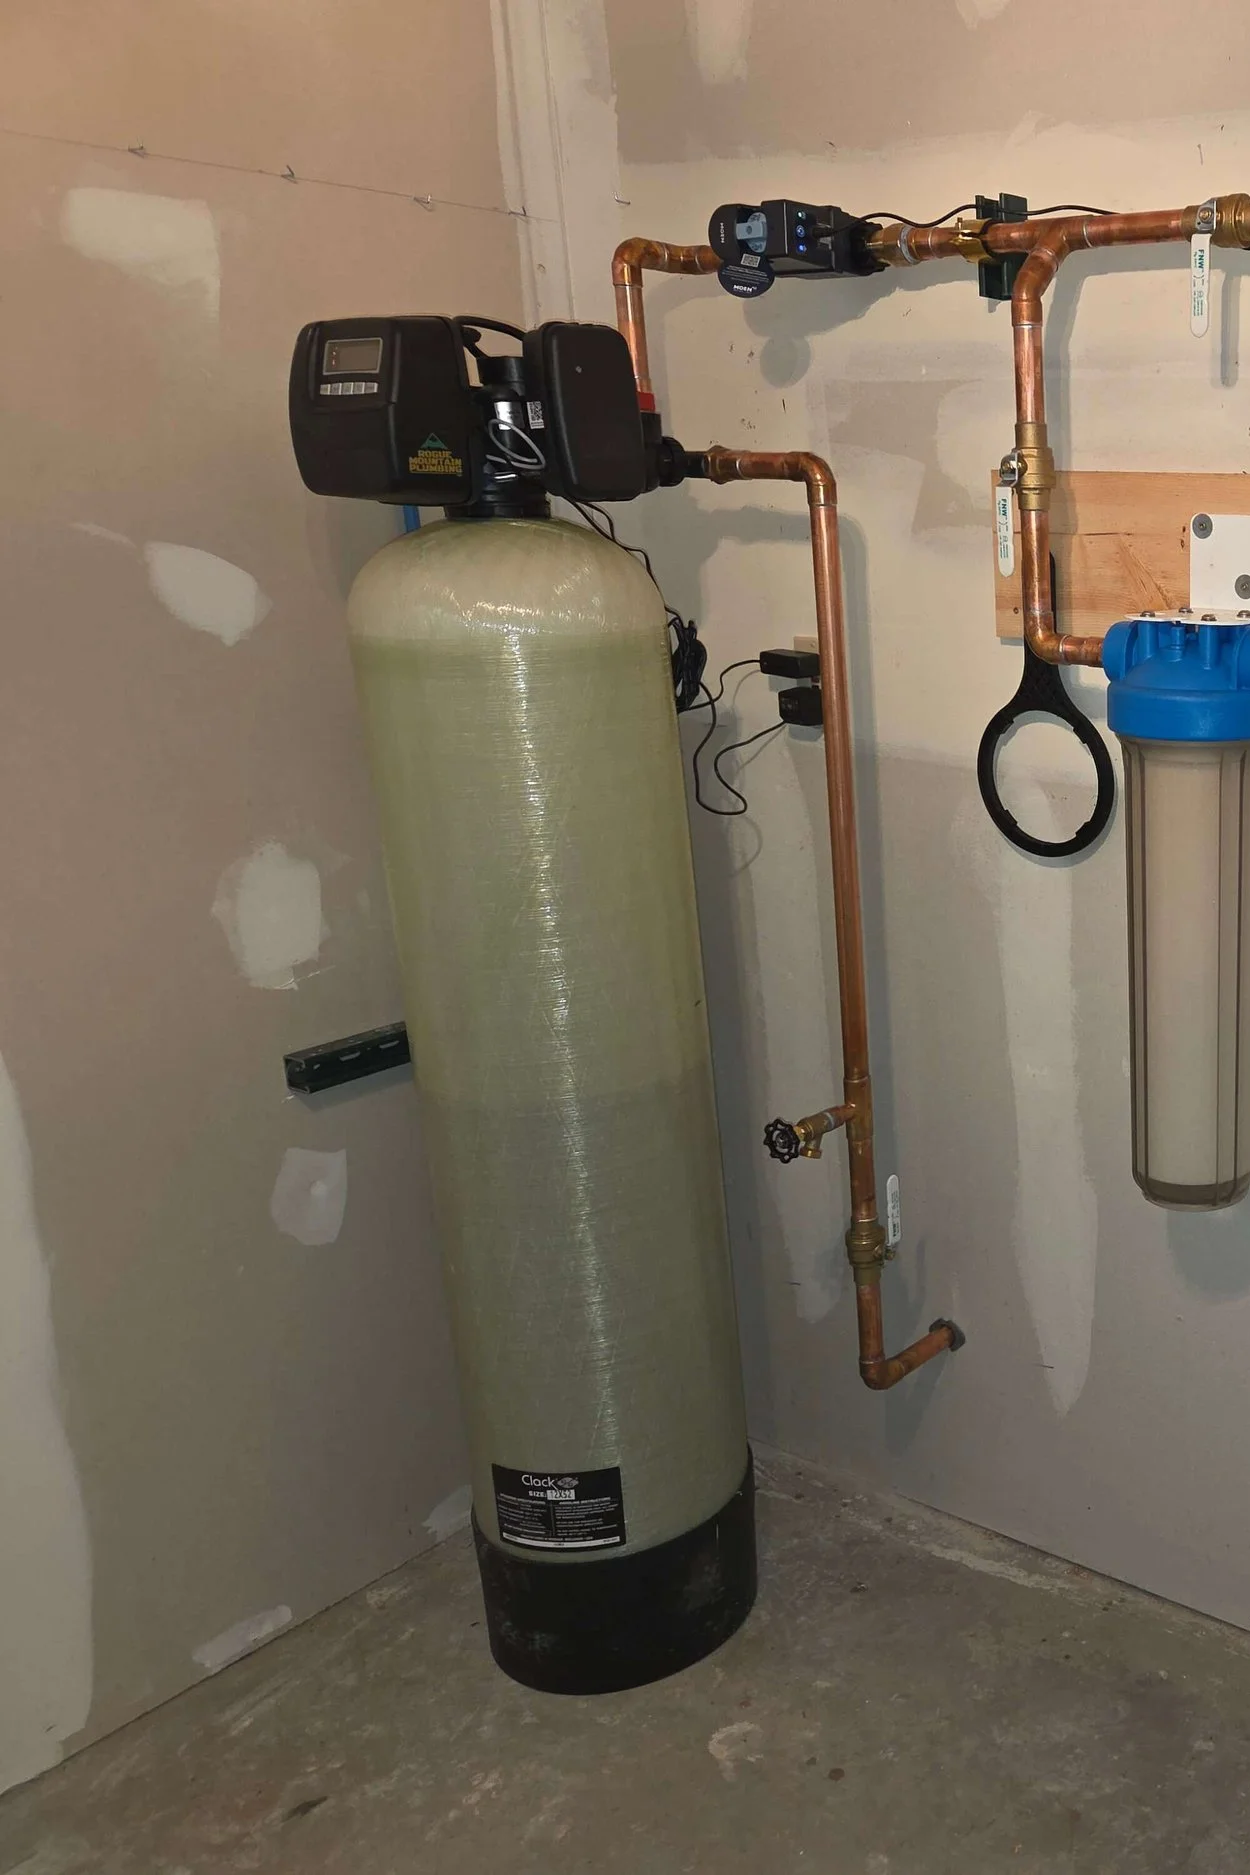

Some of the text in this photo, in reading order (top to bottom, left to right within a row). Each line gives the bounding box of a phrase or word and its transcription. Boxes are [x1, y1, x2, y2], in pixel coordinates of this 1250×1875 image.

[733, 284, 753, 292] MOEN
[417, 450, 452, 458] ROGUE
[409, 456, 462, 466] MOUNTAIN
[409, 463, 463, 473] PLUMBING
[521, 1474, 559, 1491] Clack
